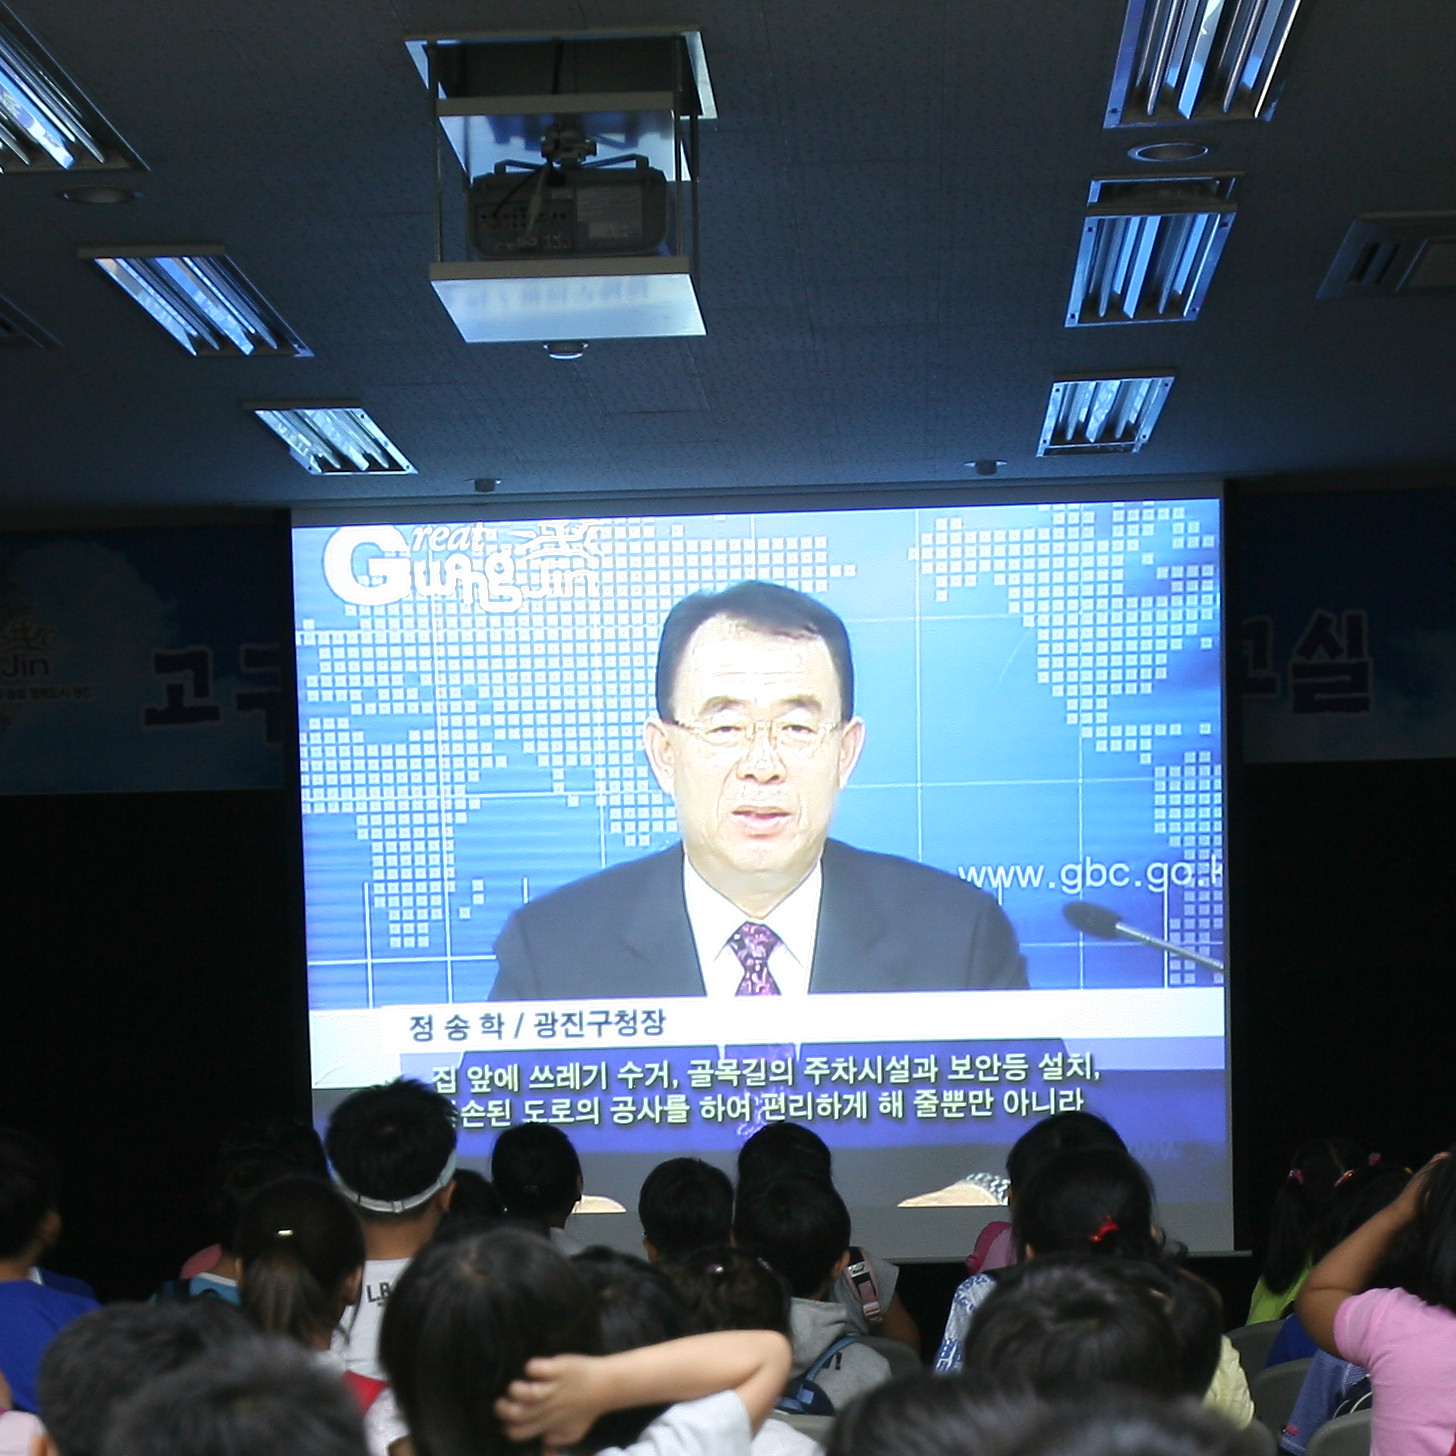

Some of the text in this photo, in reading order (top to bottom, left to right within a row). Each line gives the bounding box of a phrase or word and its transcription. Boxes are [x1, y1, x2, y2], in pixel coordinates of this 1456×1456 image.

[533, 1007, 667, 1039] 광진구청장
[432, 1051, 1102, 1095] 집 앞에 쓰레기 수거, 골목길의 주차시설과 보안등 설치,
[450, 1086, 1085, 1129] 손된 도로의 공사를 하여 편리하게 해 줄뿐만 아니라
